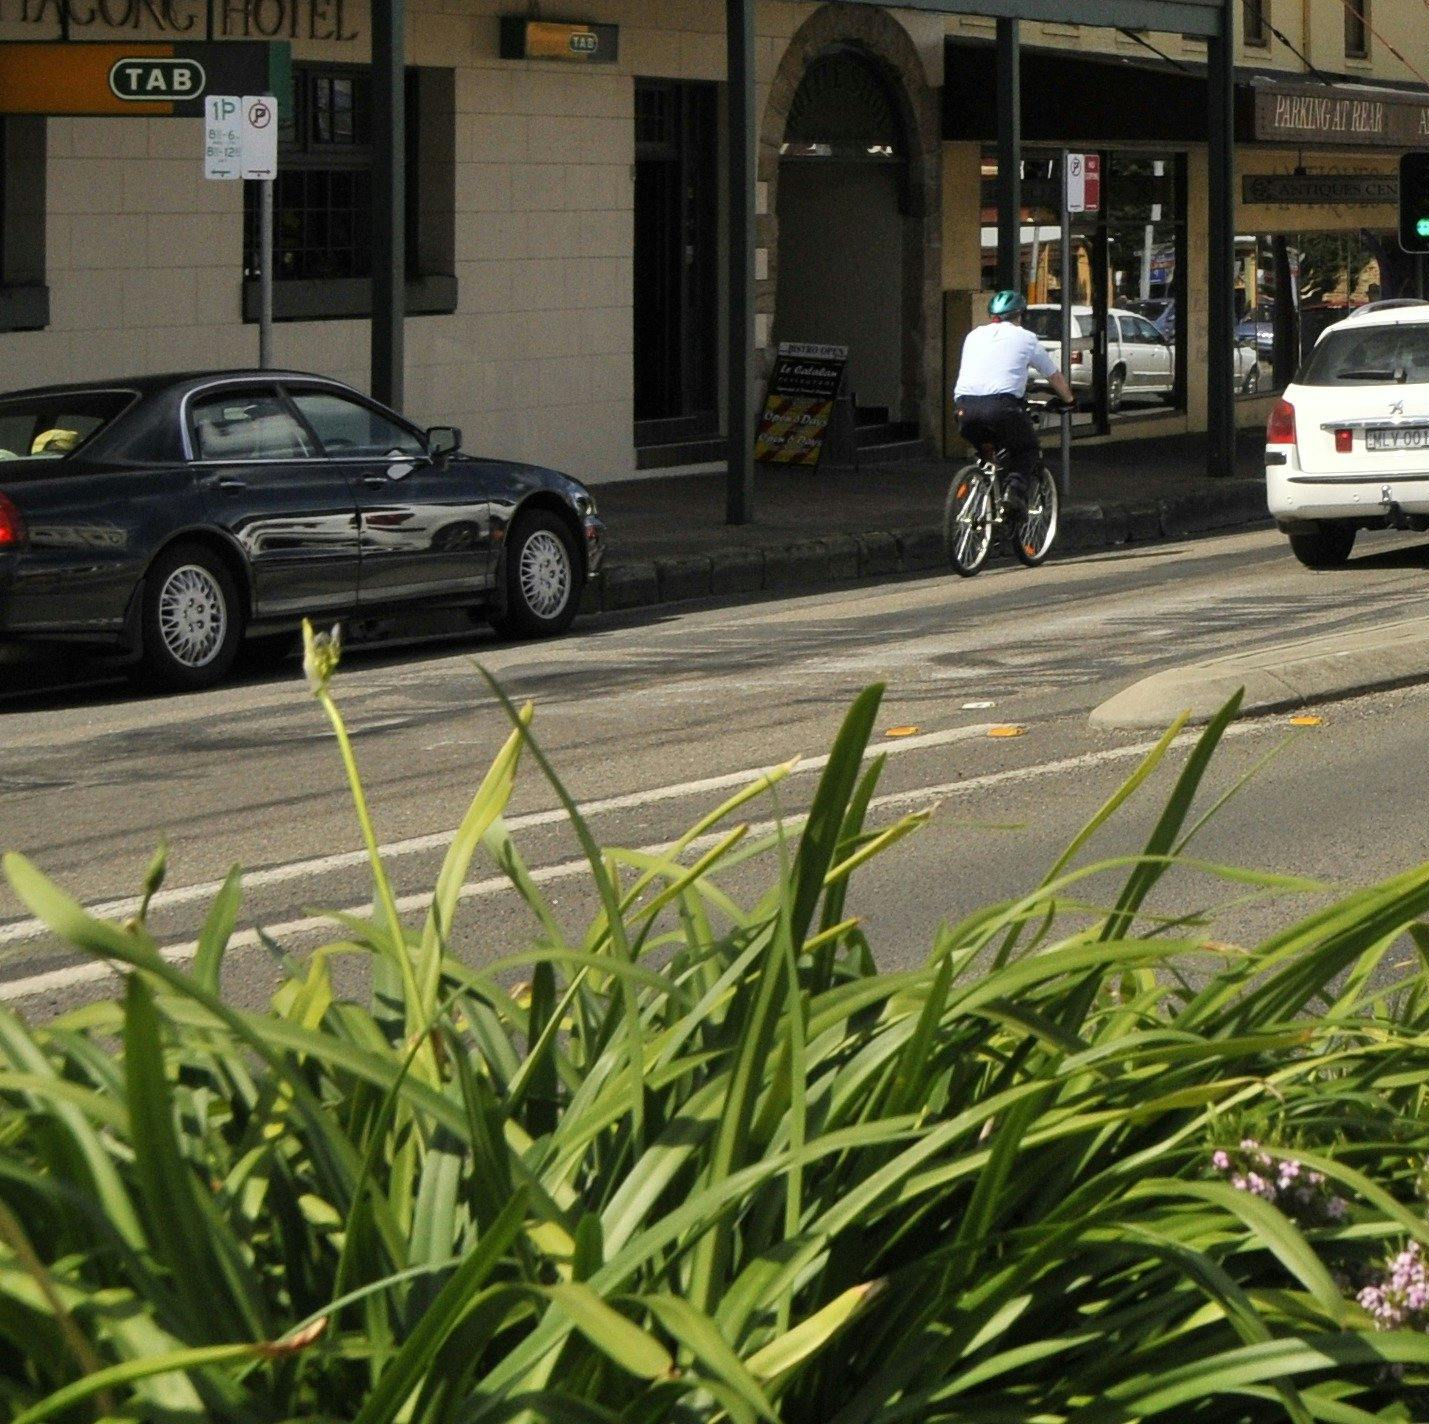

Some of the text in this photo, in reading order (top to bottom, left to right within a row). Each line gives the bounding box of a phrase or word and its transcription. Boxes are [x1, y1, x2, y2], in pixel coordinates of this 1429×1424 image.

[572, 36, 594, 49] TAB
[126, 68, 193, 92] TAB
[1275, 94, 1331, 131] PARKING
[1331, 99, 1349, 131] AT
[1350, 100, 1384, 133] REAR
[1280, 183, 1400, 198] ANTIQUES CEN
[820, 346, 845, 356] OPEN
